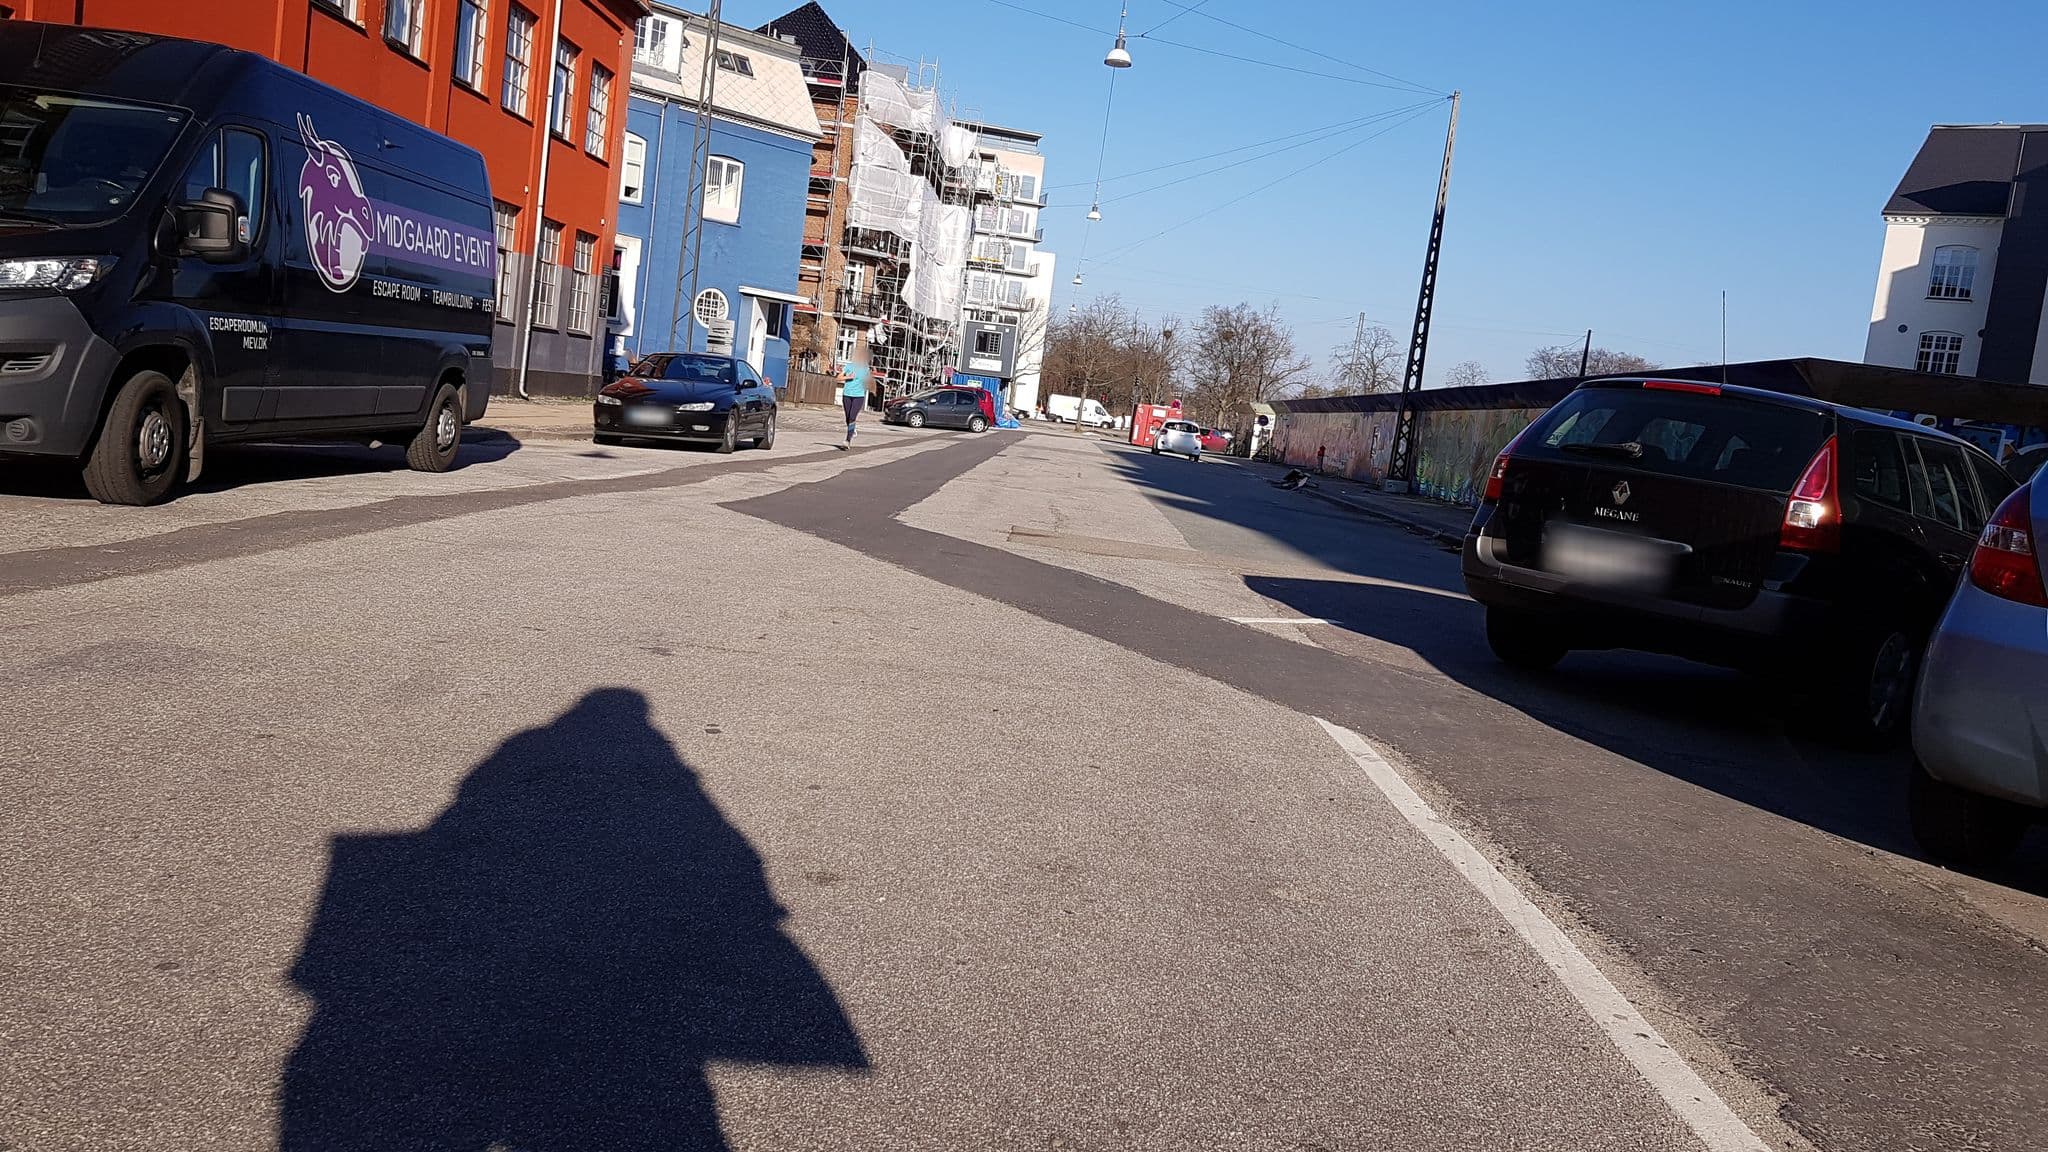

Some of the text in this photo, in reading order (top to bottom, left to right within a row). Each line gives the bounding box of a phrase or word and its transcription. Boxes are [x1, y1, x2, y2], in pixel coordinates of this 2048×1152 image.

[376, 210, 492, 269] MIDGAARD EVENT
[373, 280, 400, 299] ESCAPE
[401, 285, 420, 301] ROOM
[432, 290, 474, 310] TEAMBUILDING
[482, 298, 495, 312] FEST
[209, 316, 268, 334] ESCAPEROOM.DK
[243, 336, 268, 350] MEV.DK
[1594, 506, 1640, 522] MEGANE
